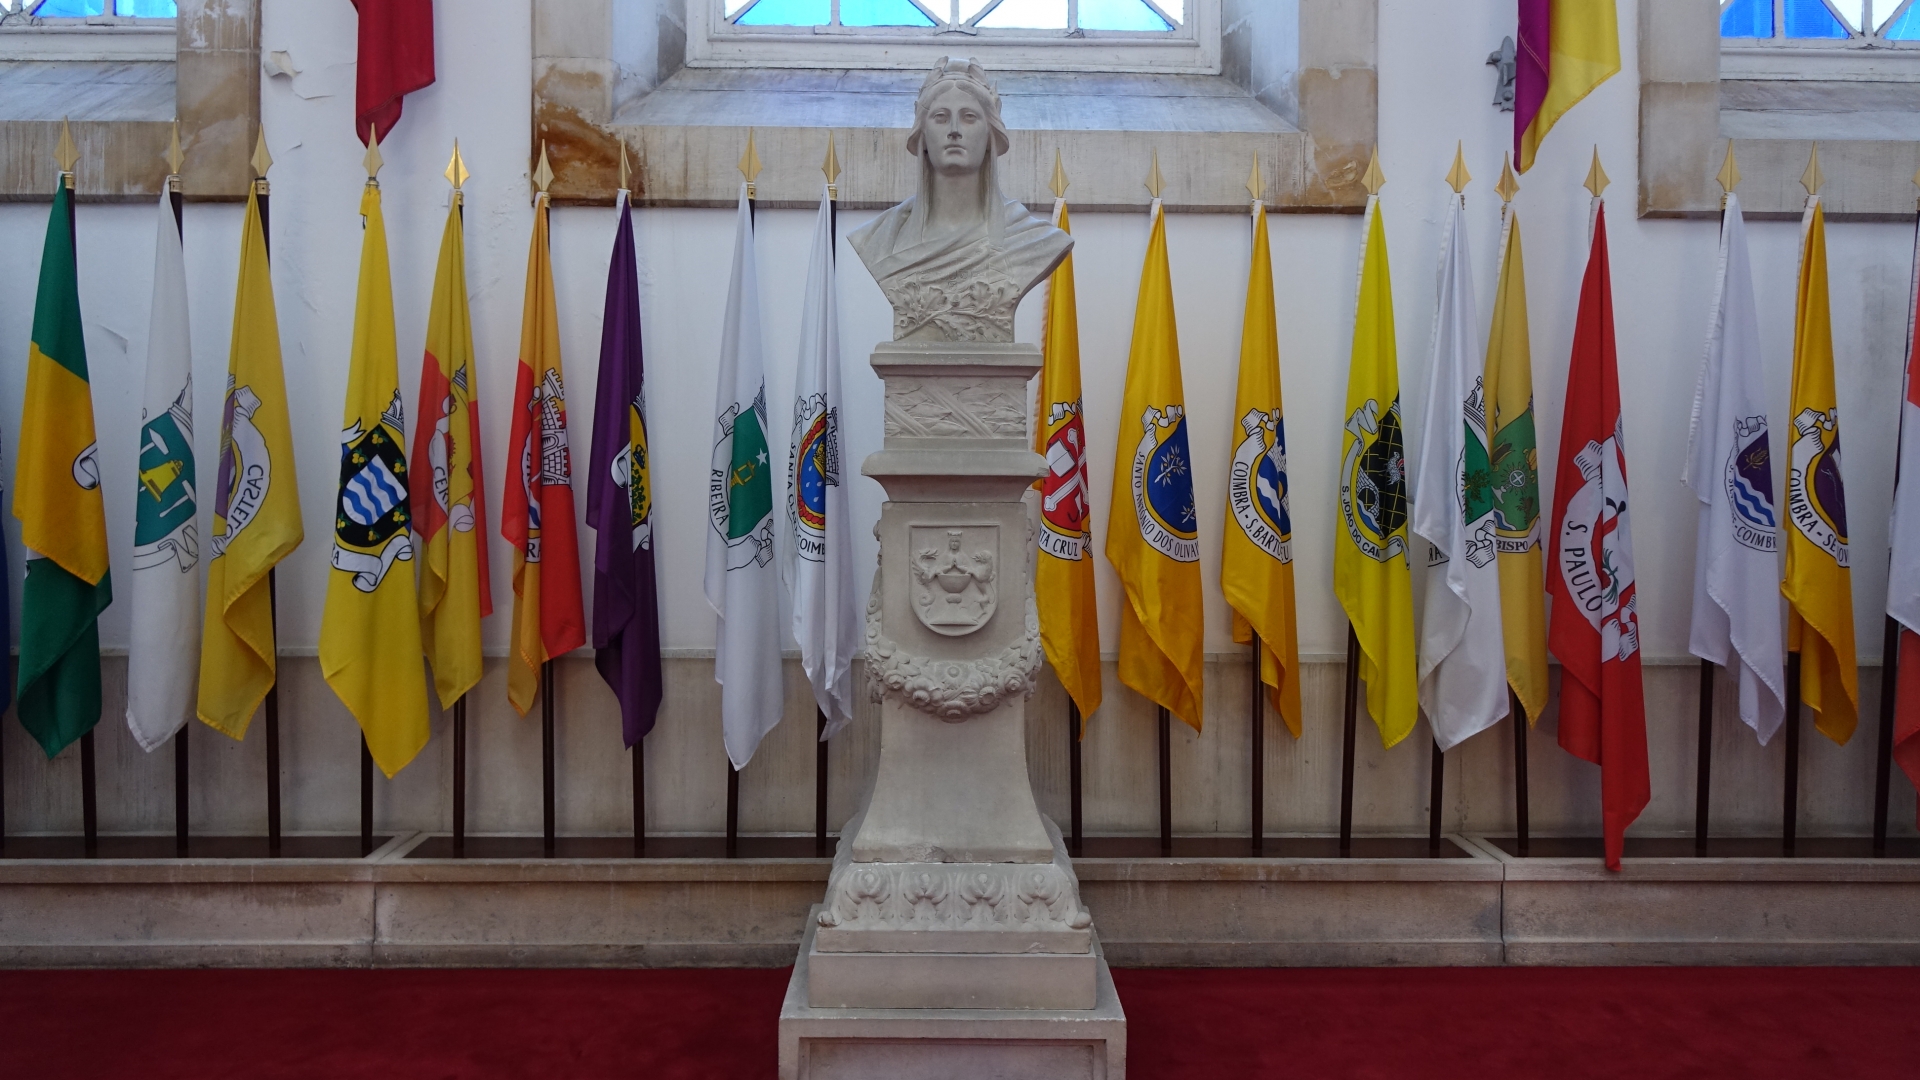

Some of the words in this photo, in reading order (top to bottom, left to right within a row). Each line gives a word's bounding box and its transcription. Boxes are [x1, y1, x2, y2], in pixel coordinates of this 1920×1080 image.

[434, 466, 449, 505] CER
[787, 442, 796, 490] SANTA
[711, 468, 730, 526] RIBEIRA
[1134, 451, 1146, 489] SANTO
[1152, 529, 1174, 552] DOS
[1232, 461, 1251, 515] COIMBRA
[1245, 518, 1259, 533] S.
[1341, 485, 1349, 497] S.
[1351, 529, 1362, 544] DO
[1789, 468, 1819, 533] COIMBRA
[1052, 538, 1078, 557] CRUZ
[1565, 520, 1588, 536] S.
[1564, 547, 1602, 612] PAULO
